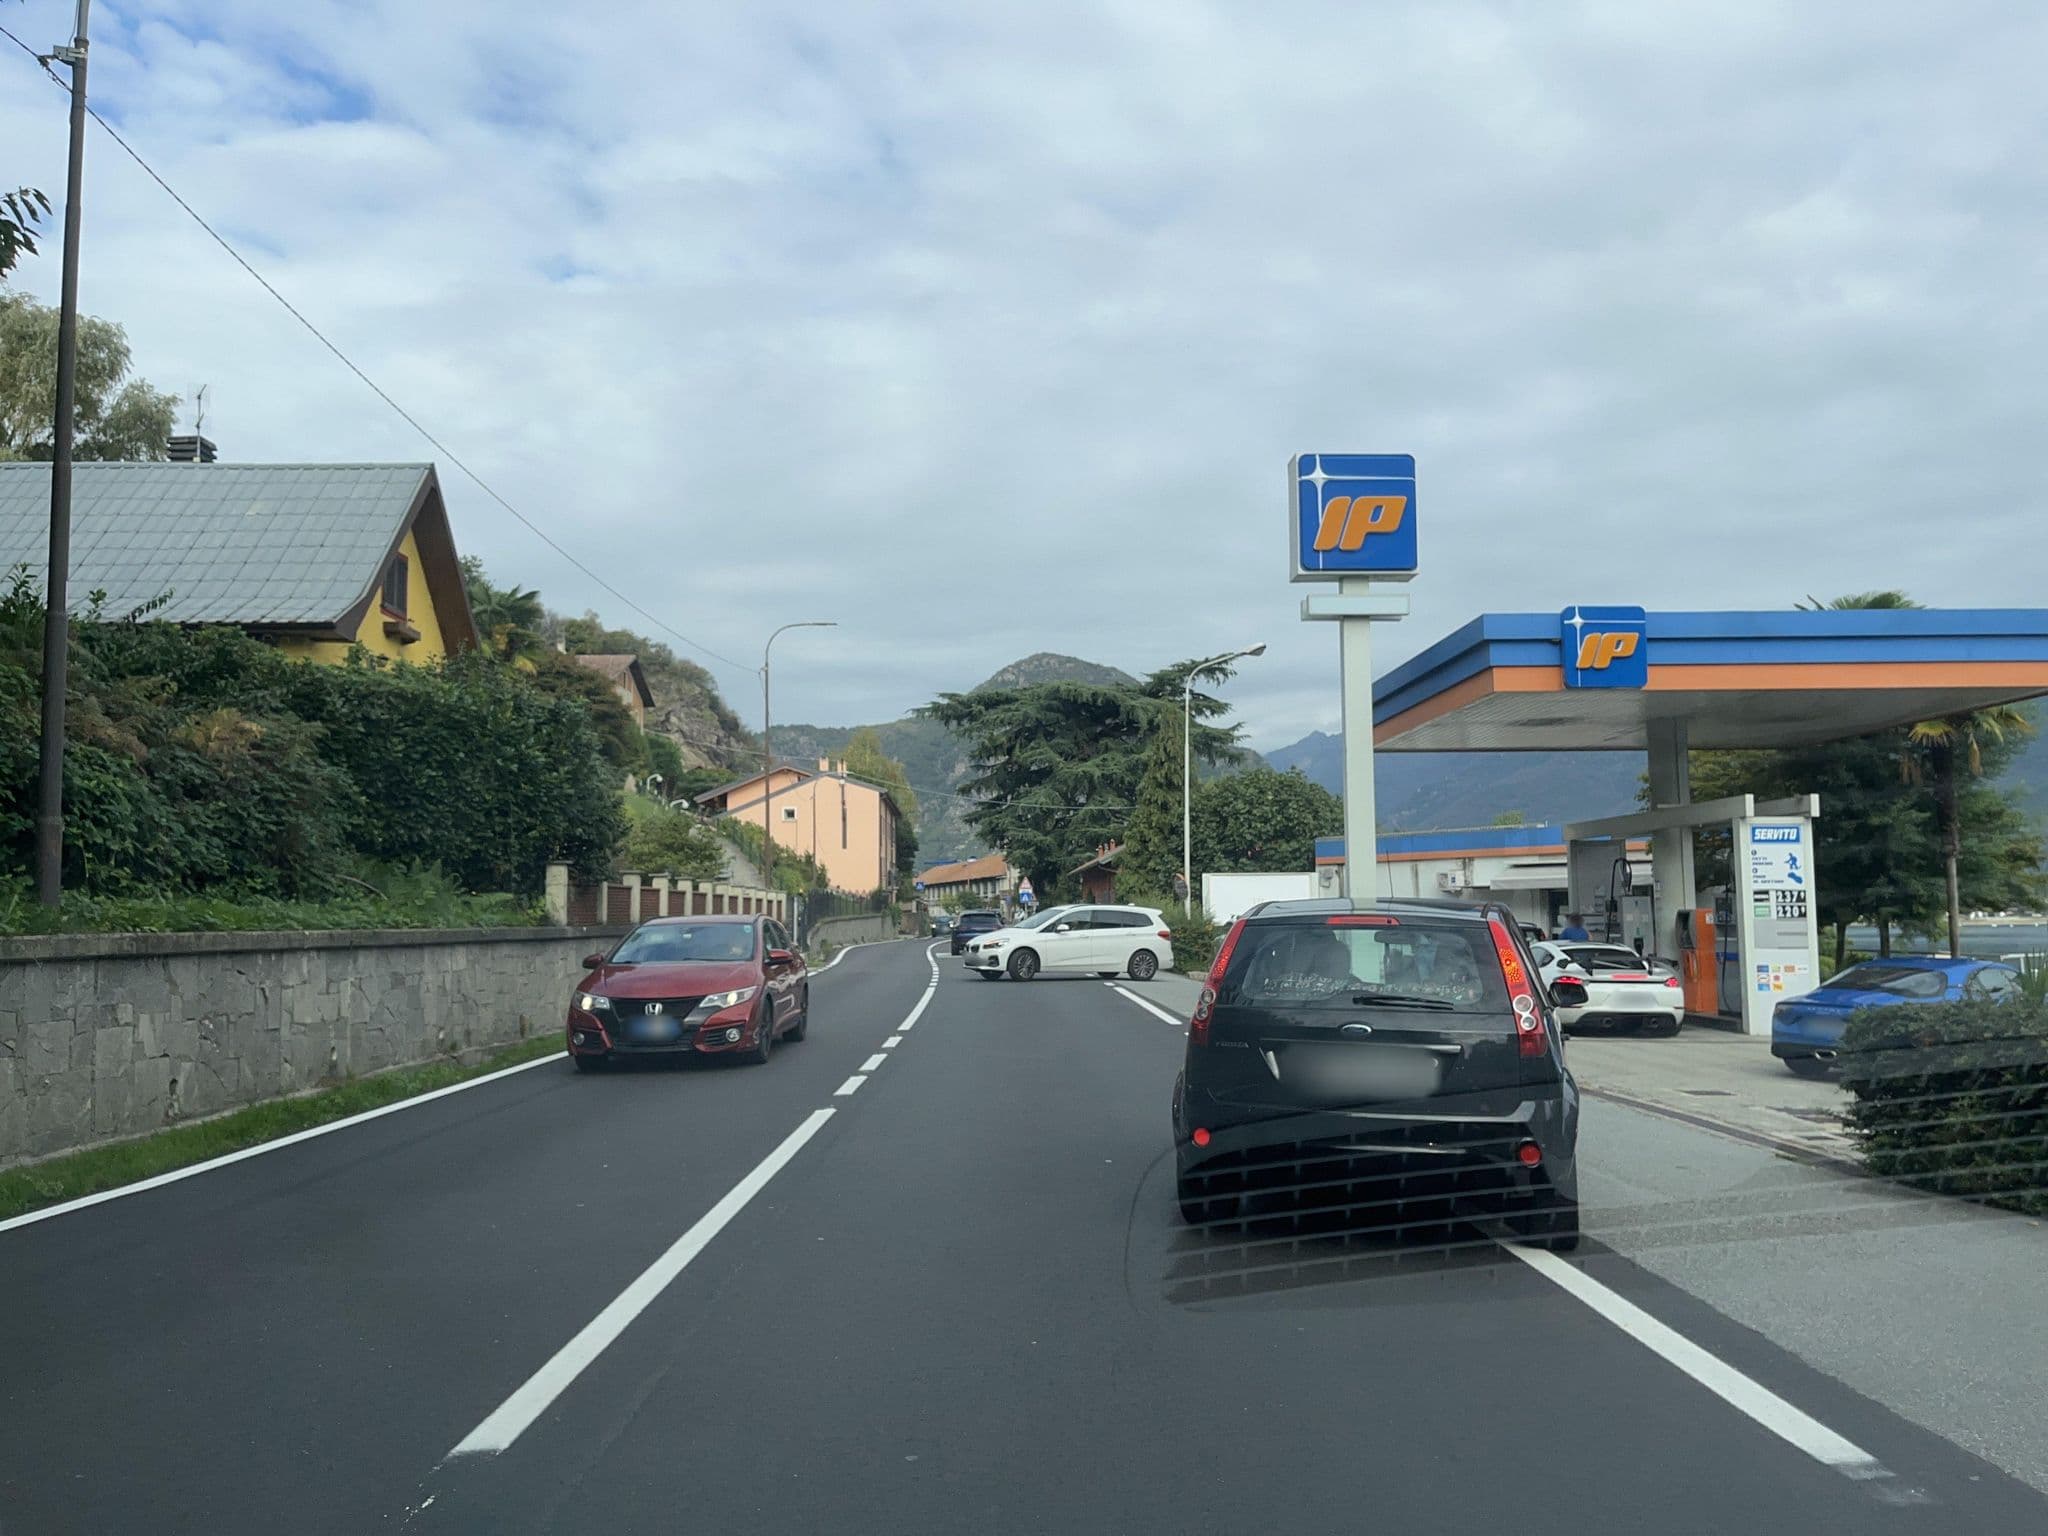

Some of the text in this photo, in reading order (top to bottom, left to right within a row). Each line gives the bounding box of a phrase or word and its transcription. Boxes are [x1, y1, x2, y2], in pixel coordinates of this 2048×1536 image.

[1313, 496, 1407, 551] IP
[1576, 632, 1639, 669] IP
[1754, 828, 1798, 841] SERVITO
